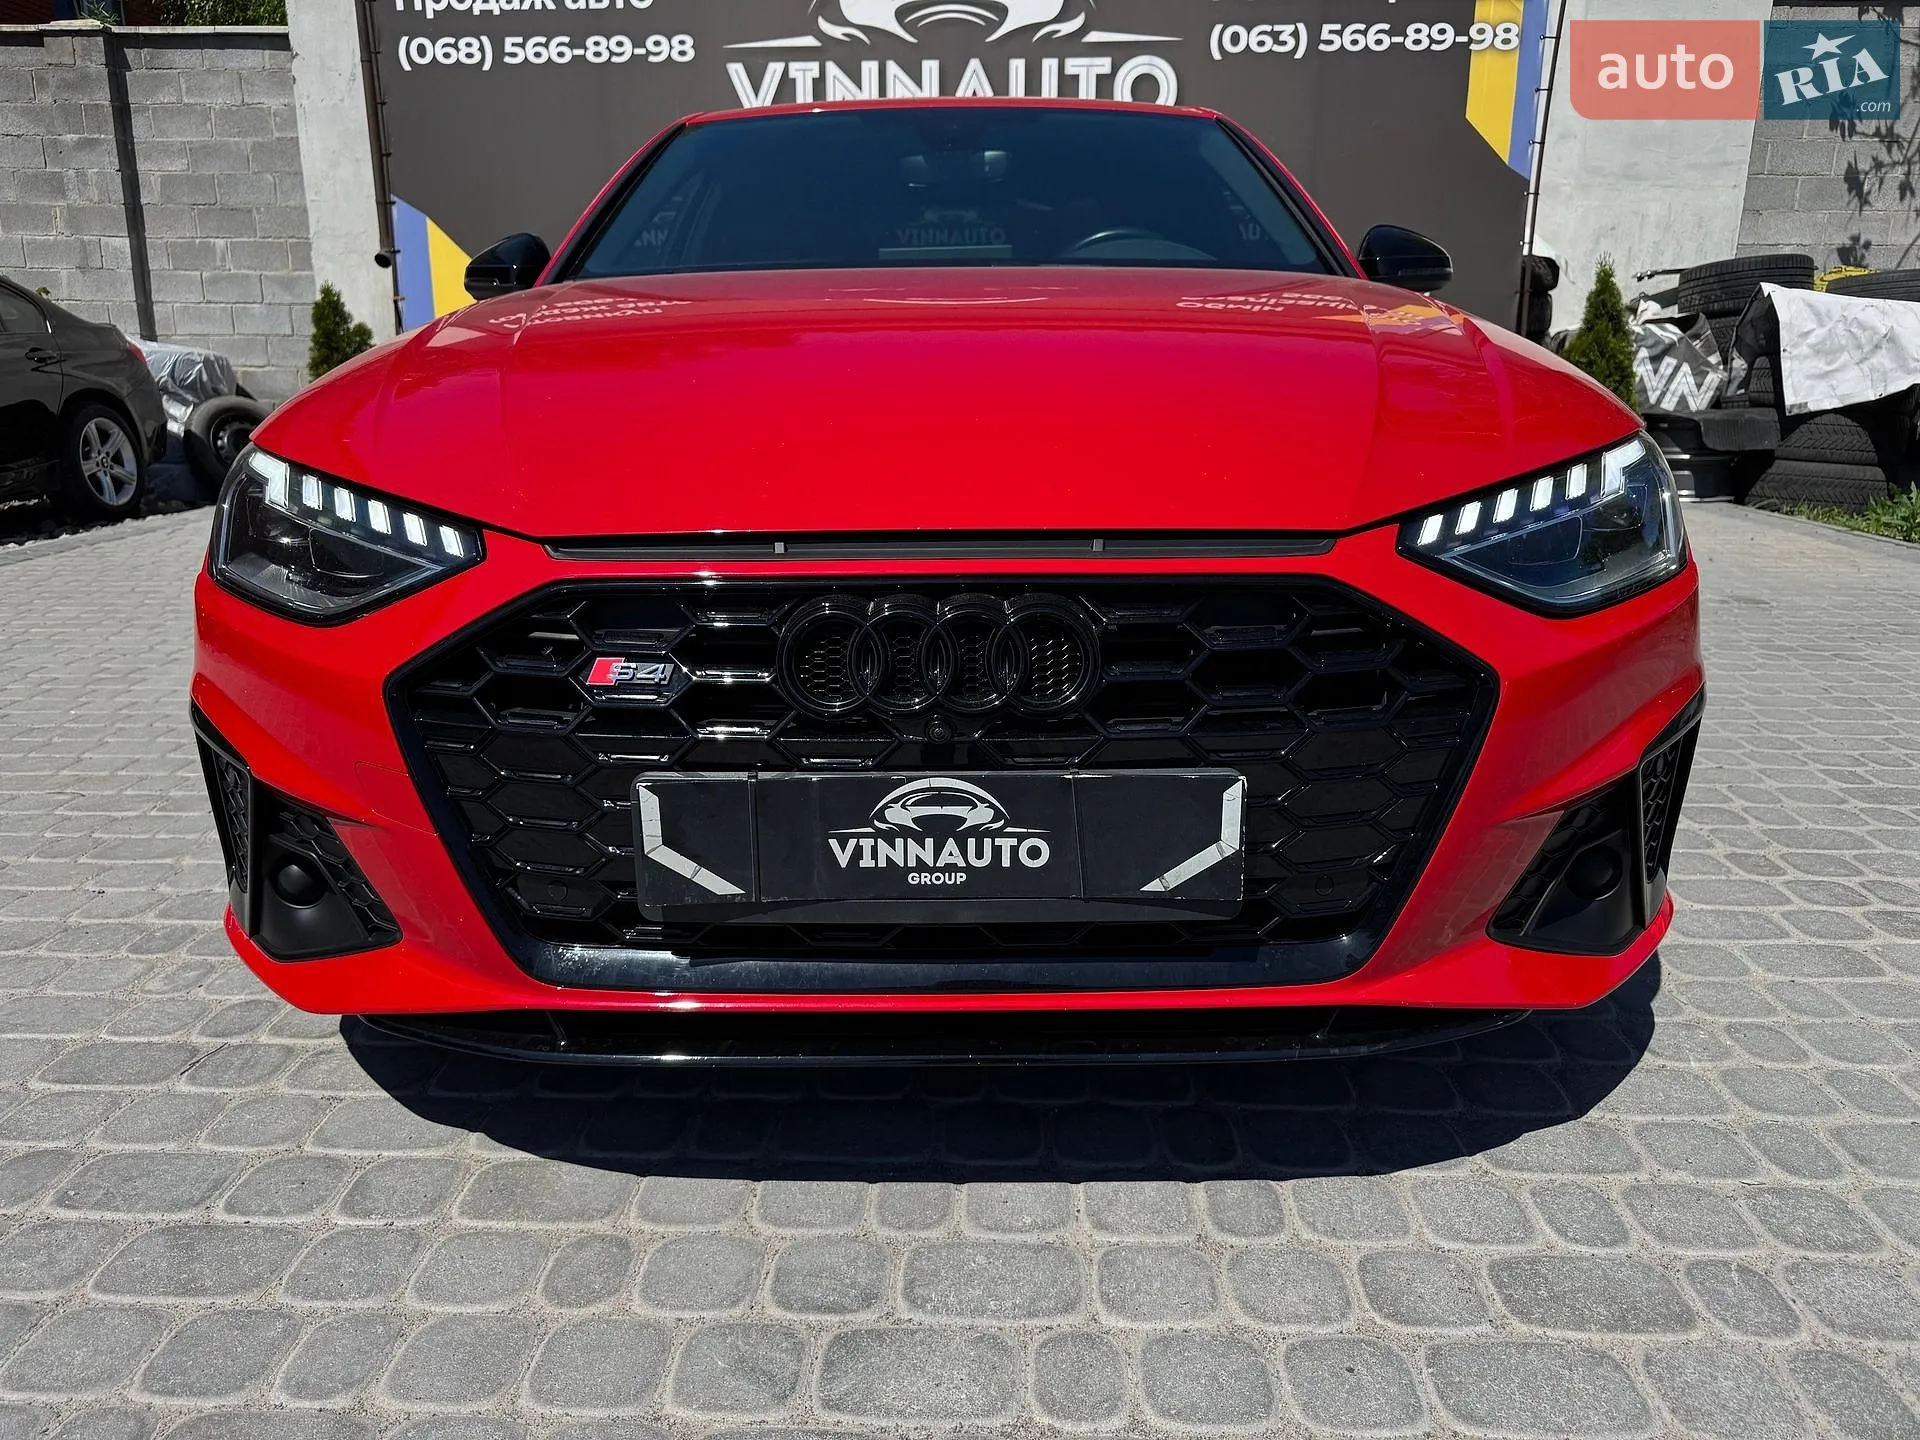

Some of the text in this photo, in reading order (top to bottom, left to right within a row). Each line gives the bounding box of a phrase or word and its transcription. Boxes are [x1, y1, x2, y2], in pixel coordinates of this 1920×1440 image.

[398, 34, 696, 71] (068) 566-89-98
[1209, 22, 1520, 60] (063) 566-89-98
[725, 54, 1179, 109] VINNAUTO
[607, 662, 666, 682] S4
[828, 837, 1050, 868] VINNAUTO
[907, 872, 967, 885] GROUP
